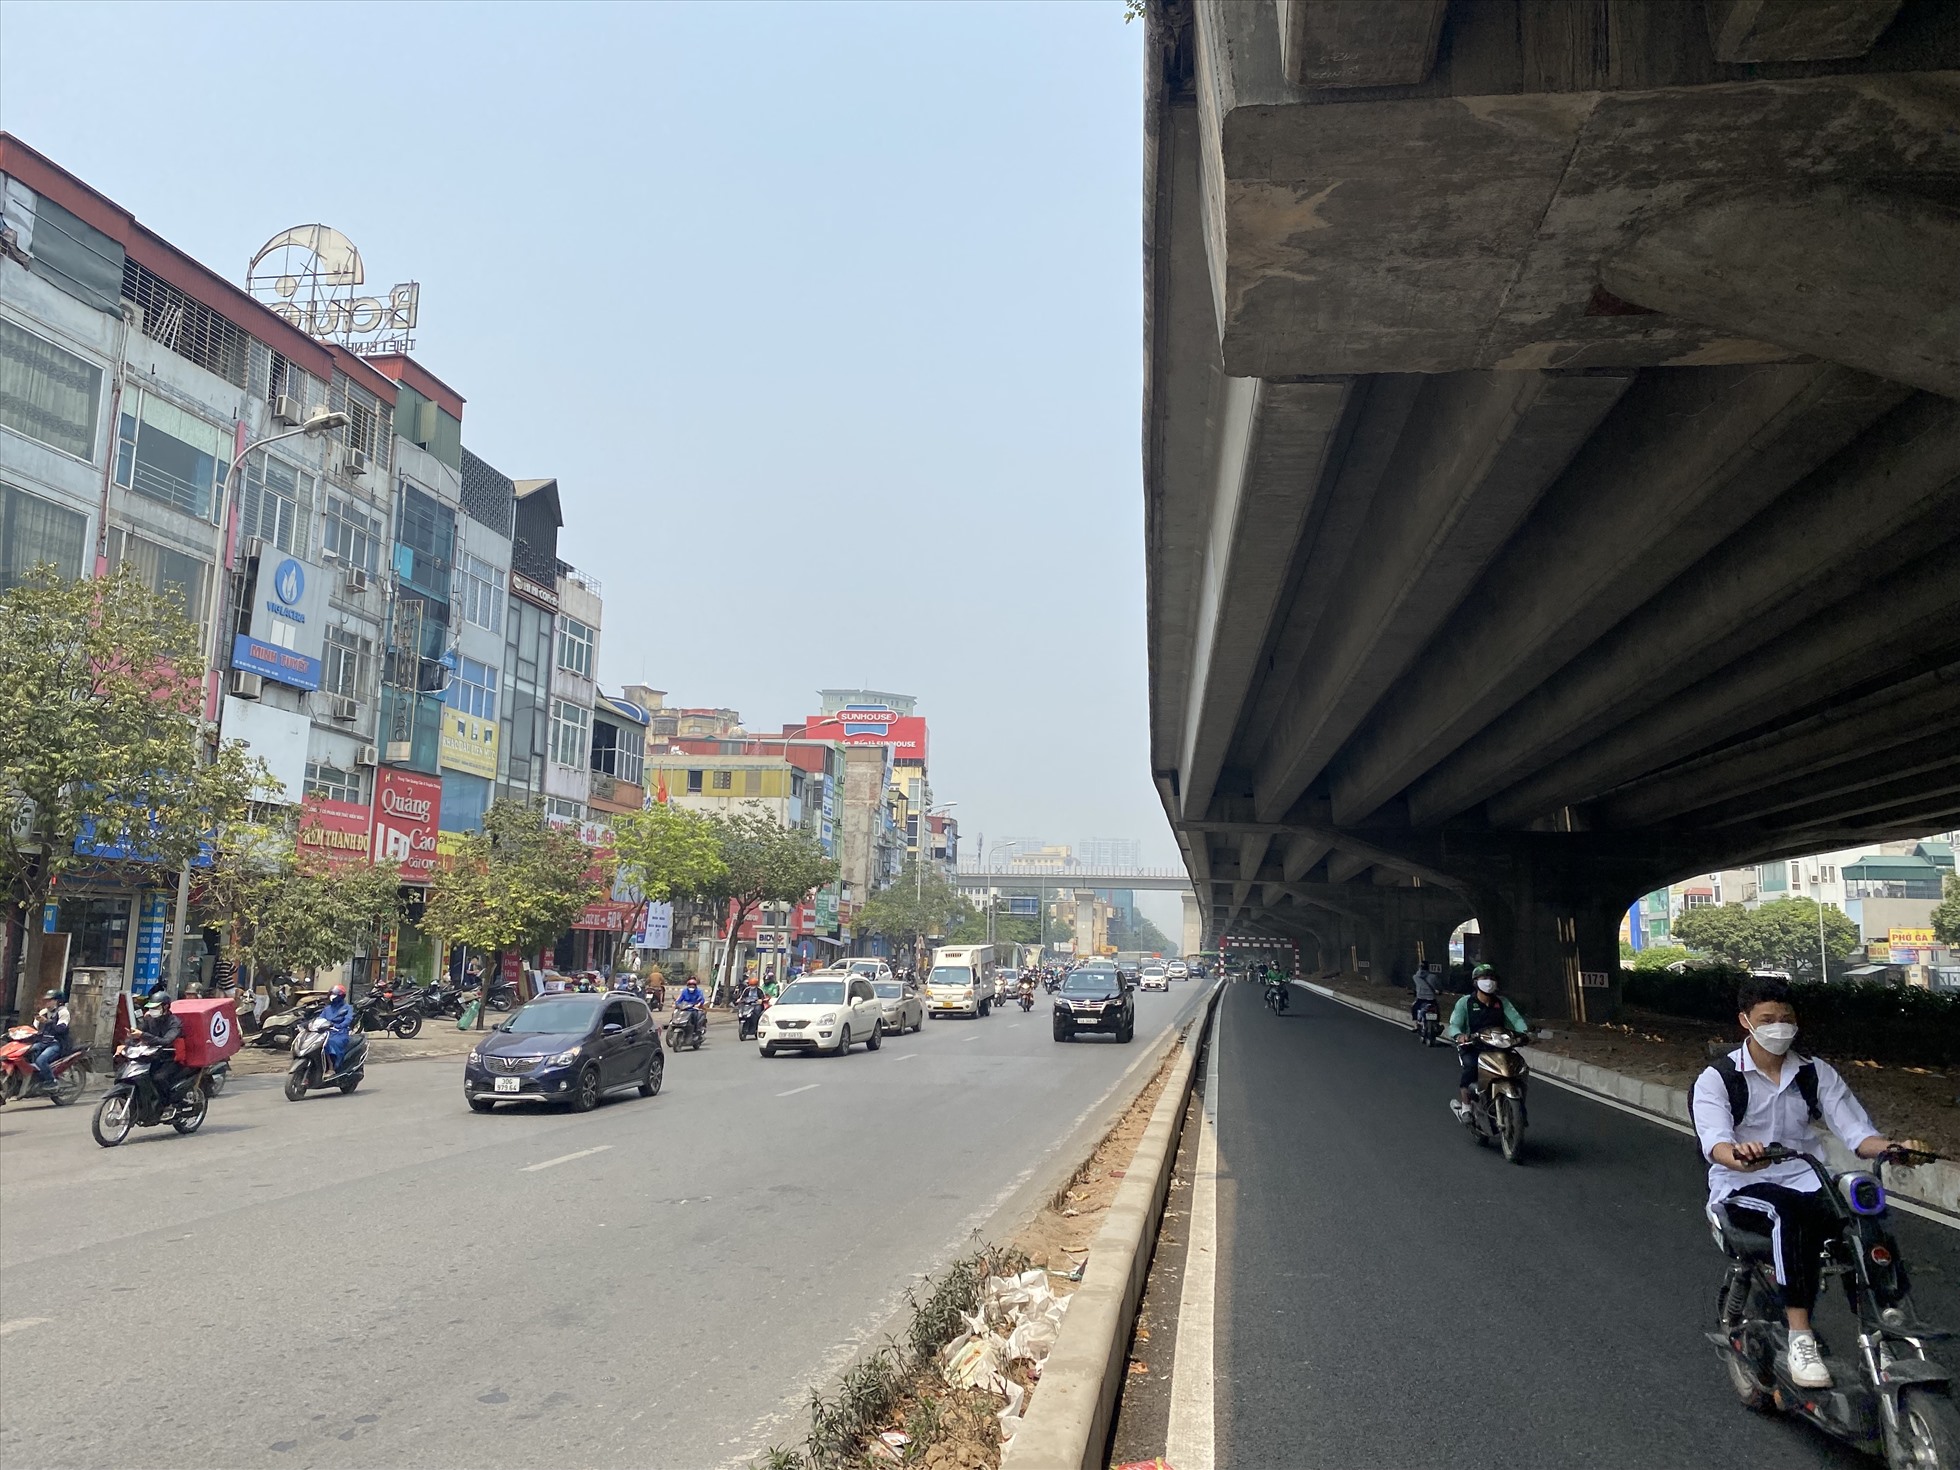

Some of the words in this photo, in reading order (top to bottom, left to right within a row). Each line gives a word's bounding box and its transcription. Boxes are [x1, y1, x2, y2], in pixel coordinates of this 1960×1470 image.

[266, 601, 305, 624] VIGLACERA
[250, 644, 278, 664] MINH
[280, 654, 309, 674] TUYẾT
[382, 787, 432, 823] Quảng
[375, 822, 410, 864] LED
[410, 827, 436, 852] Cáo
[1892, 932, 1912, 942] PHỞ
[1914, 932, 1928, 942] GÀ
[1581, 973, 1605, 986] T173
